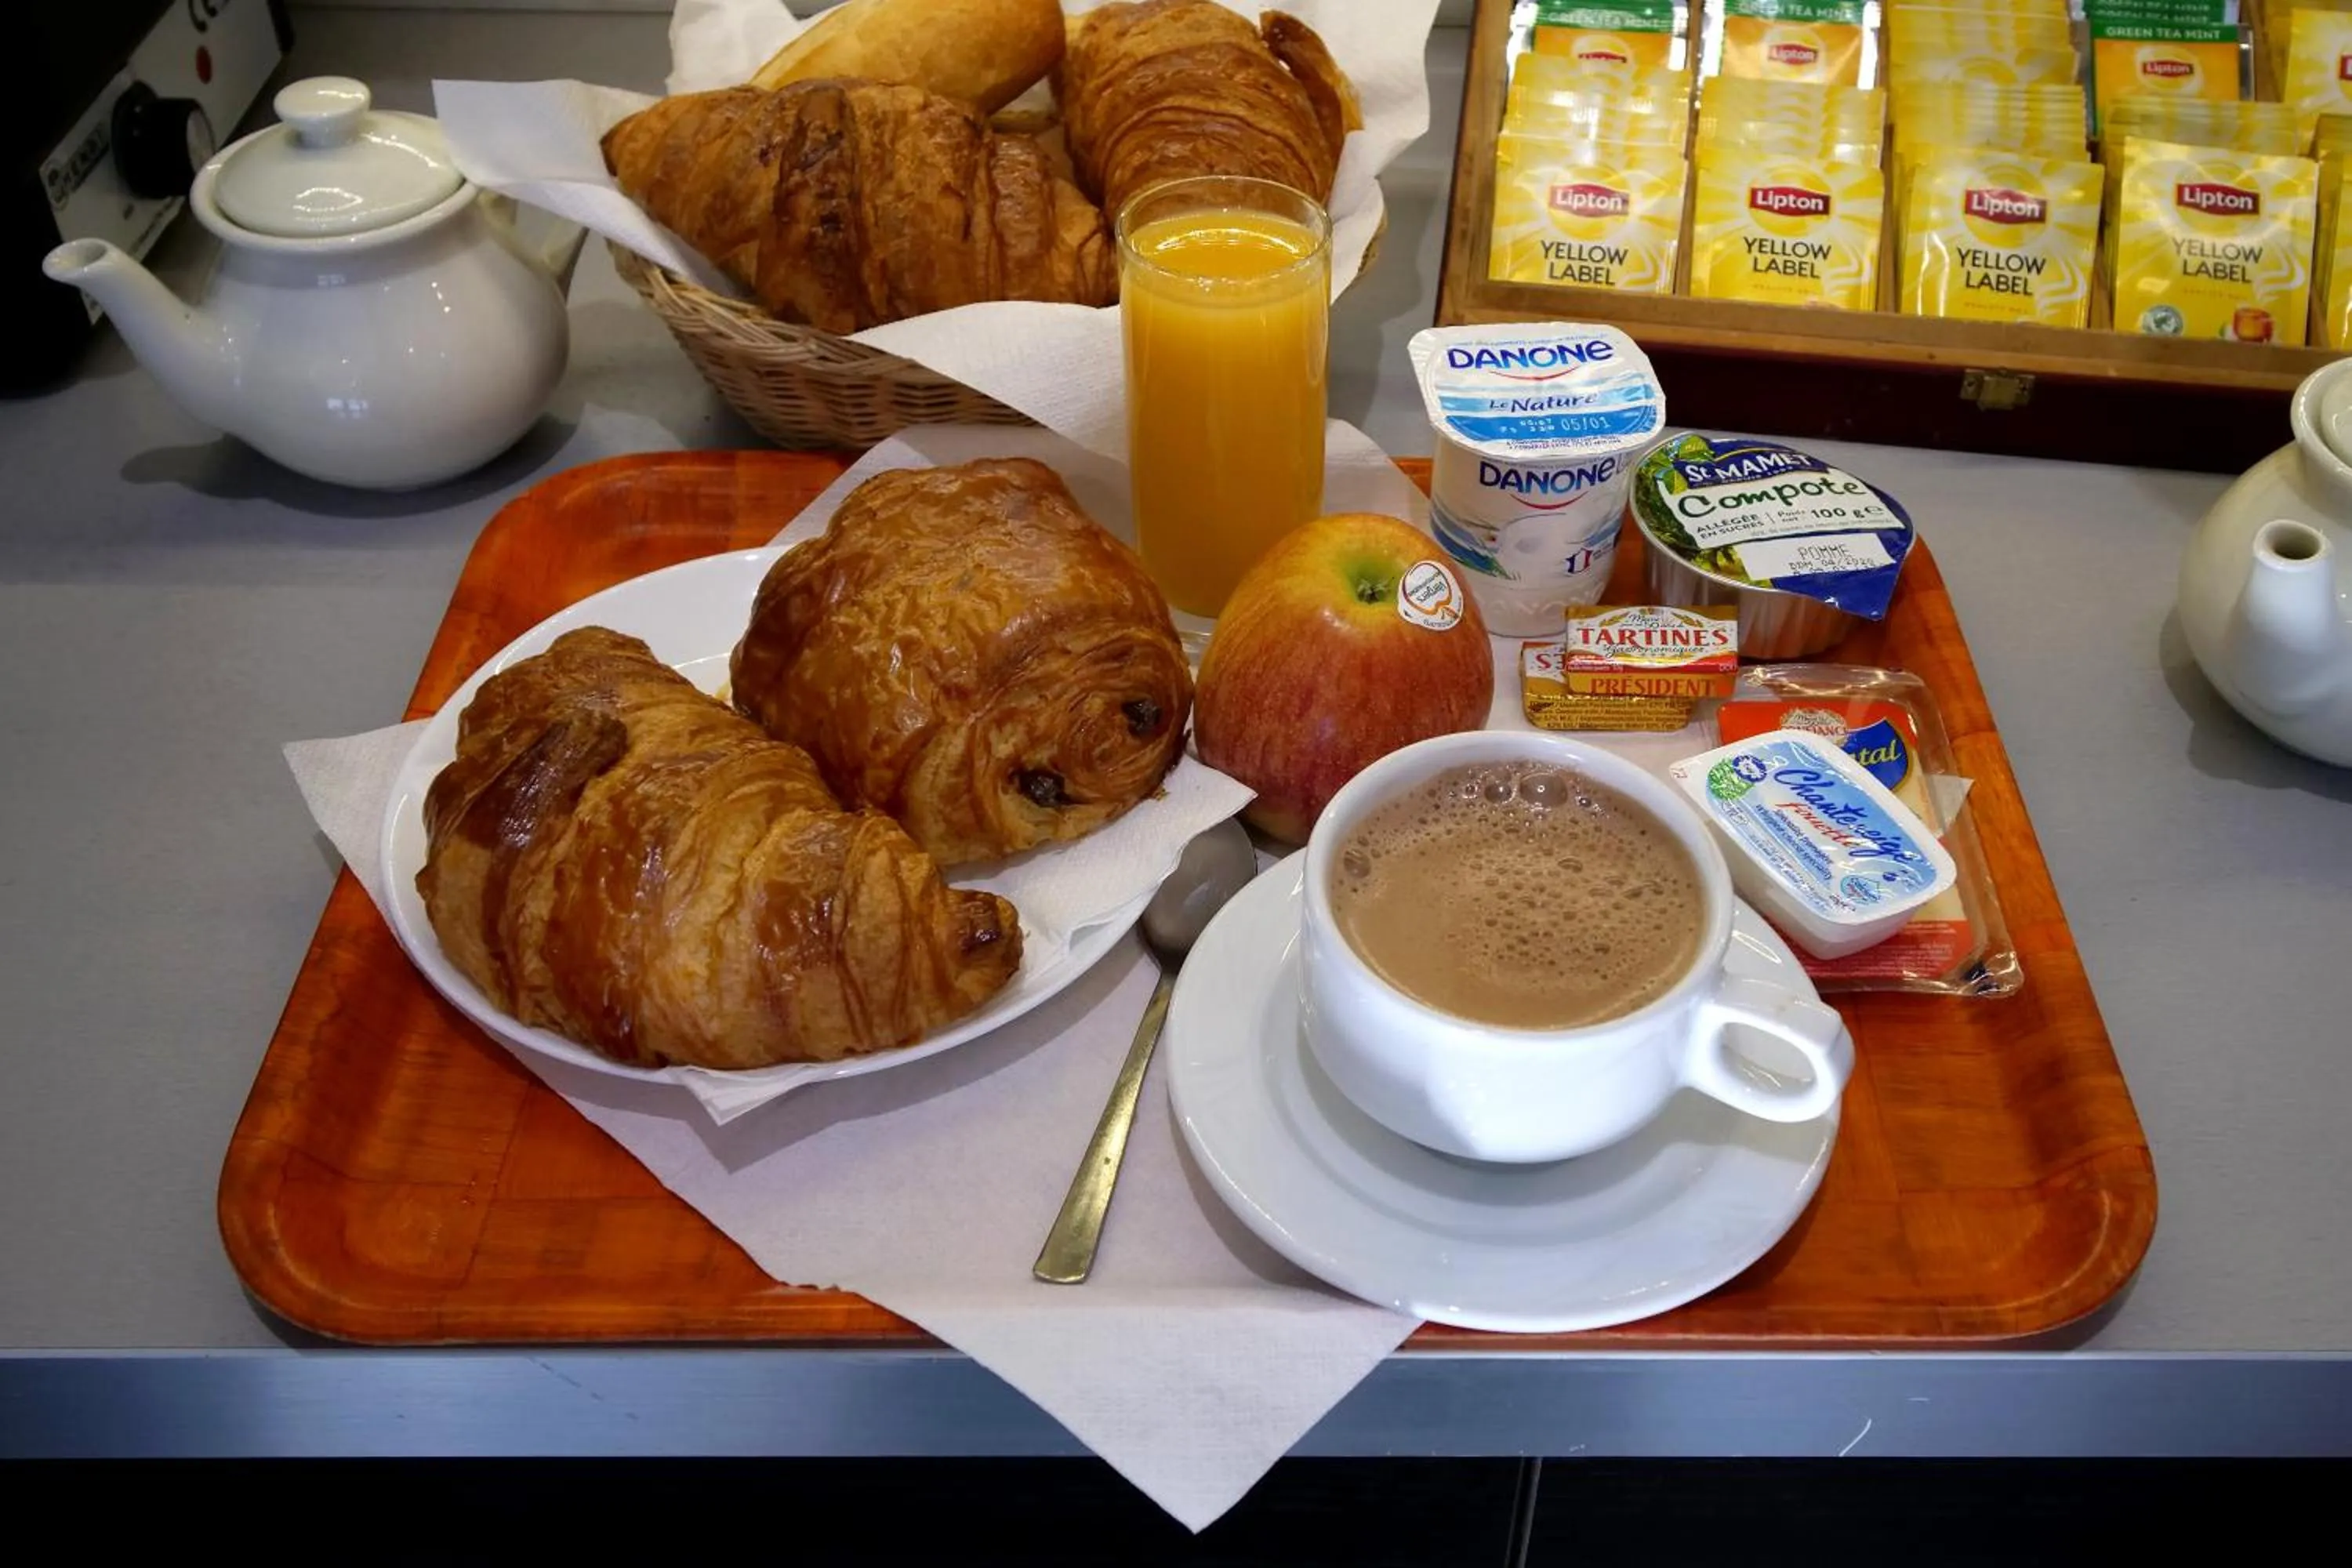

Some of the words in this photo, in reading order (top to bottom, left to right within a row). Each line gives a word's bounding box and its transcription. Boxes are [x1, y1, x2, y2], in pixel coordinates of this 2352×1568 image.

[1788, 5, 1813, 16] TEA
[2106, 27, 2152, 38] GREEN
[2157, 28, 2181, 38] TEA
[2185, 29, 2220, 39] MINT
[2147, 62, 2190, 74] Lipton
[1555, 189, 1623, 212] Lipton
[1755, 188, 1824, 213] Lipton
[1971, 194, 2039, 219] Lipton
[2183, 185, 2253, 212] Lipton
[1541, 241, 1628, 266] YELLOW
[1743, 237, 1831, 261] YELLOW
[1957, 247, 2045, 275] YELLOW
[2172, 237, 2263, 263] YELLOW
[1548, 262, 1616, 286] LABEL
[1752, 256, 1820, 279] LABEL
[2183, 260, 2252, 284] LABEL
[1965, 270, 2033, 297] LABEL
[1447, 340, 1613, 369] DANONE
[1561, 416, 1611, 431] 05/01
[1479, 457, 1615, 495] DANONE
[1715, 452, 1812, 479] MAMET
[1678, 477, 1866, 518] Compote
[1811, 508, 1846, 518] 100
[1798, 543, 1851, 560] POMME
[1577, 628, 1730, 647] TARTINES
[1591, 676, 1716, 696] PRÉSIDENT
